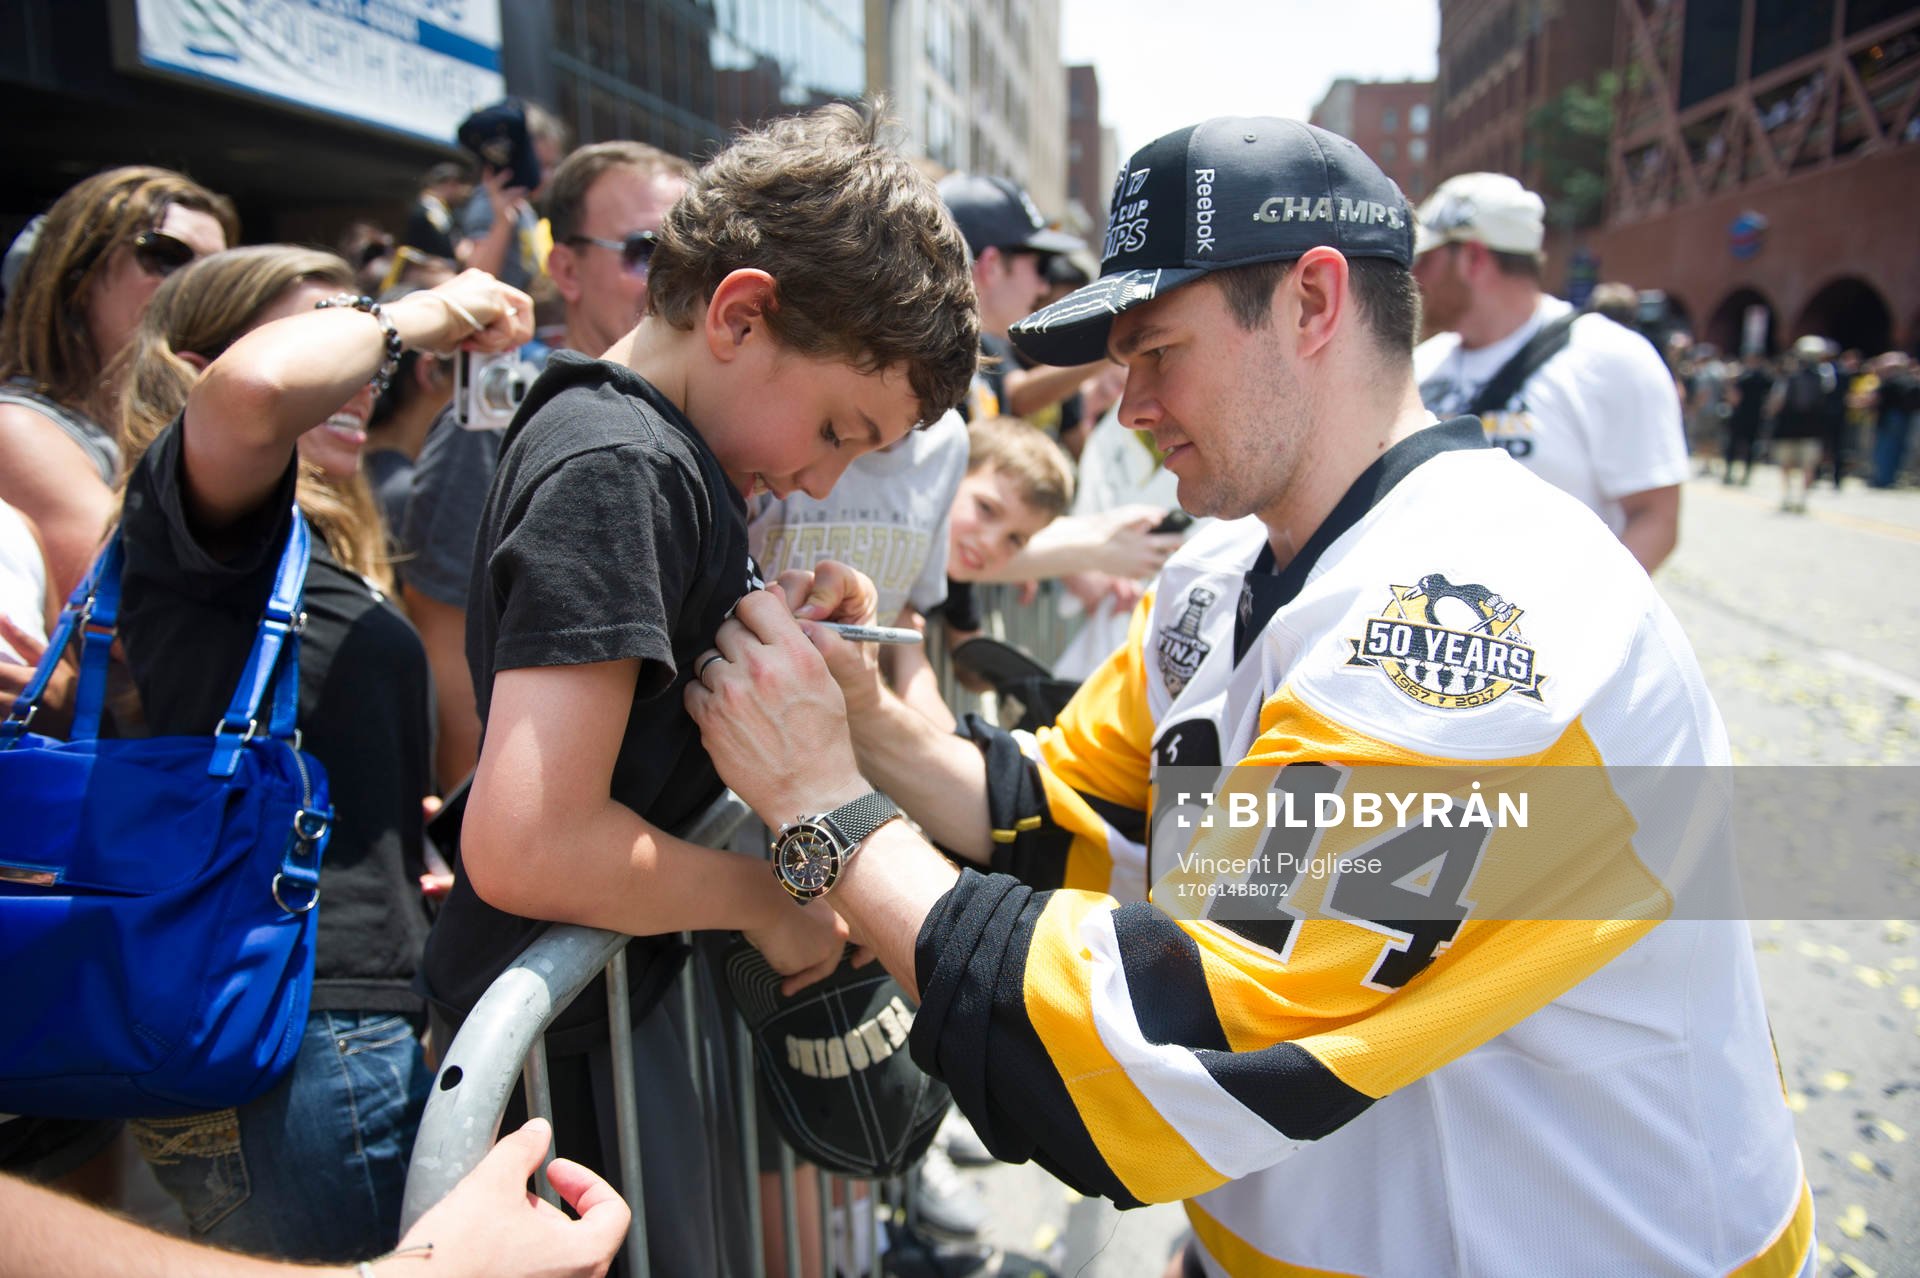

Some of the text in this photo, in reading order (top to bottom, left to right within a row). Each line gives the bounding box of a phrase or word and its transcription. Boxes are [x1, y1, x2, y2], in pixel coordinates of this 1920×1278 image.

[1118, 199, 1149, 222] CUP
[1195, 168, 1216, 254] Reebok
[1258, 196, 1402, 230] CHAMPS
[1368, 621, 1530, 680] 50 YEARS
[1391, 669, 1496, 707] 1967 2017
[1201, 760, 1497, 994] 14
